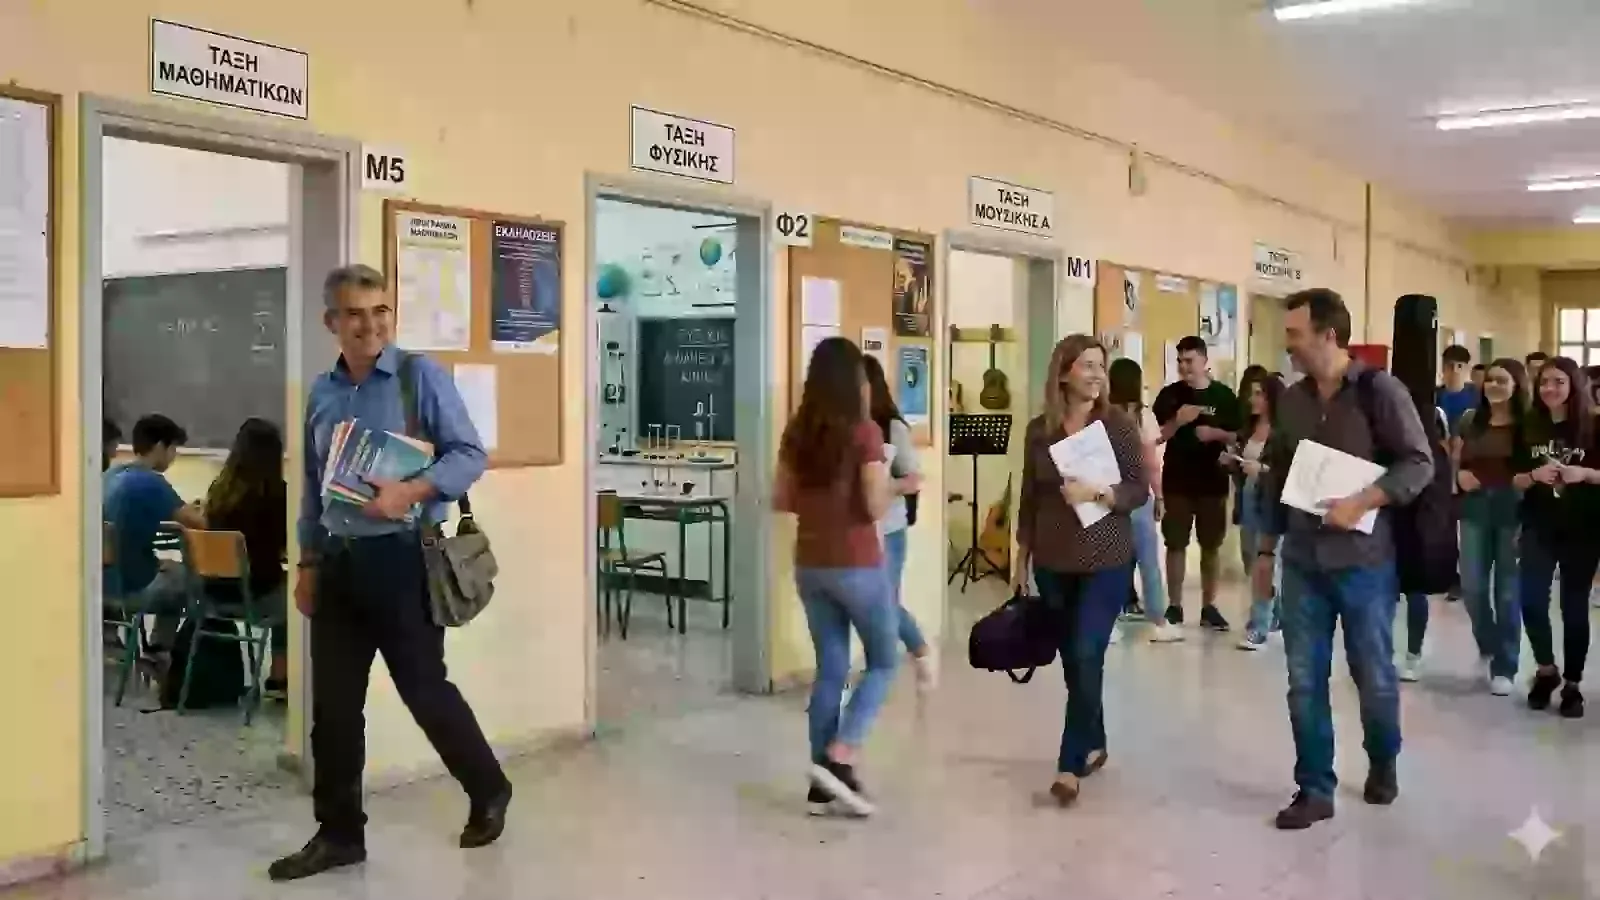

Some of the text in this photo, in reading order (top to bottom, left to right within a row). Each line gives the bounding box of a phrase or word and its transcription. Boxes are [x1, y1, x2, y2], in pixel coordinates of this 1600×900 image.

[207, 43, 259, 73] ΤΑΞΗ
[158, 60, 304, 106] ΜΑΘΗΜΑΤΙΚΩΝ
[664, 123, 705, 147] ΤΑΞΗ
[649, 143, 720, 173] ΦΥΣΙΚΗΣ
[997, 188, 1029, 208] ΤΑΞΗ
[776, 211, 809, 238] Φ2
[975, 203, 1039, 229] ΜΟΥΣΙΚΗΣ
